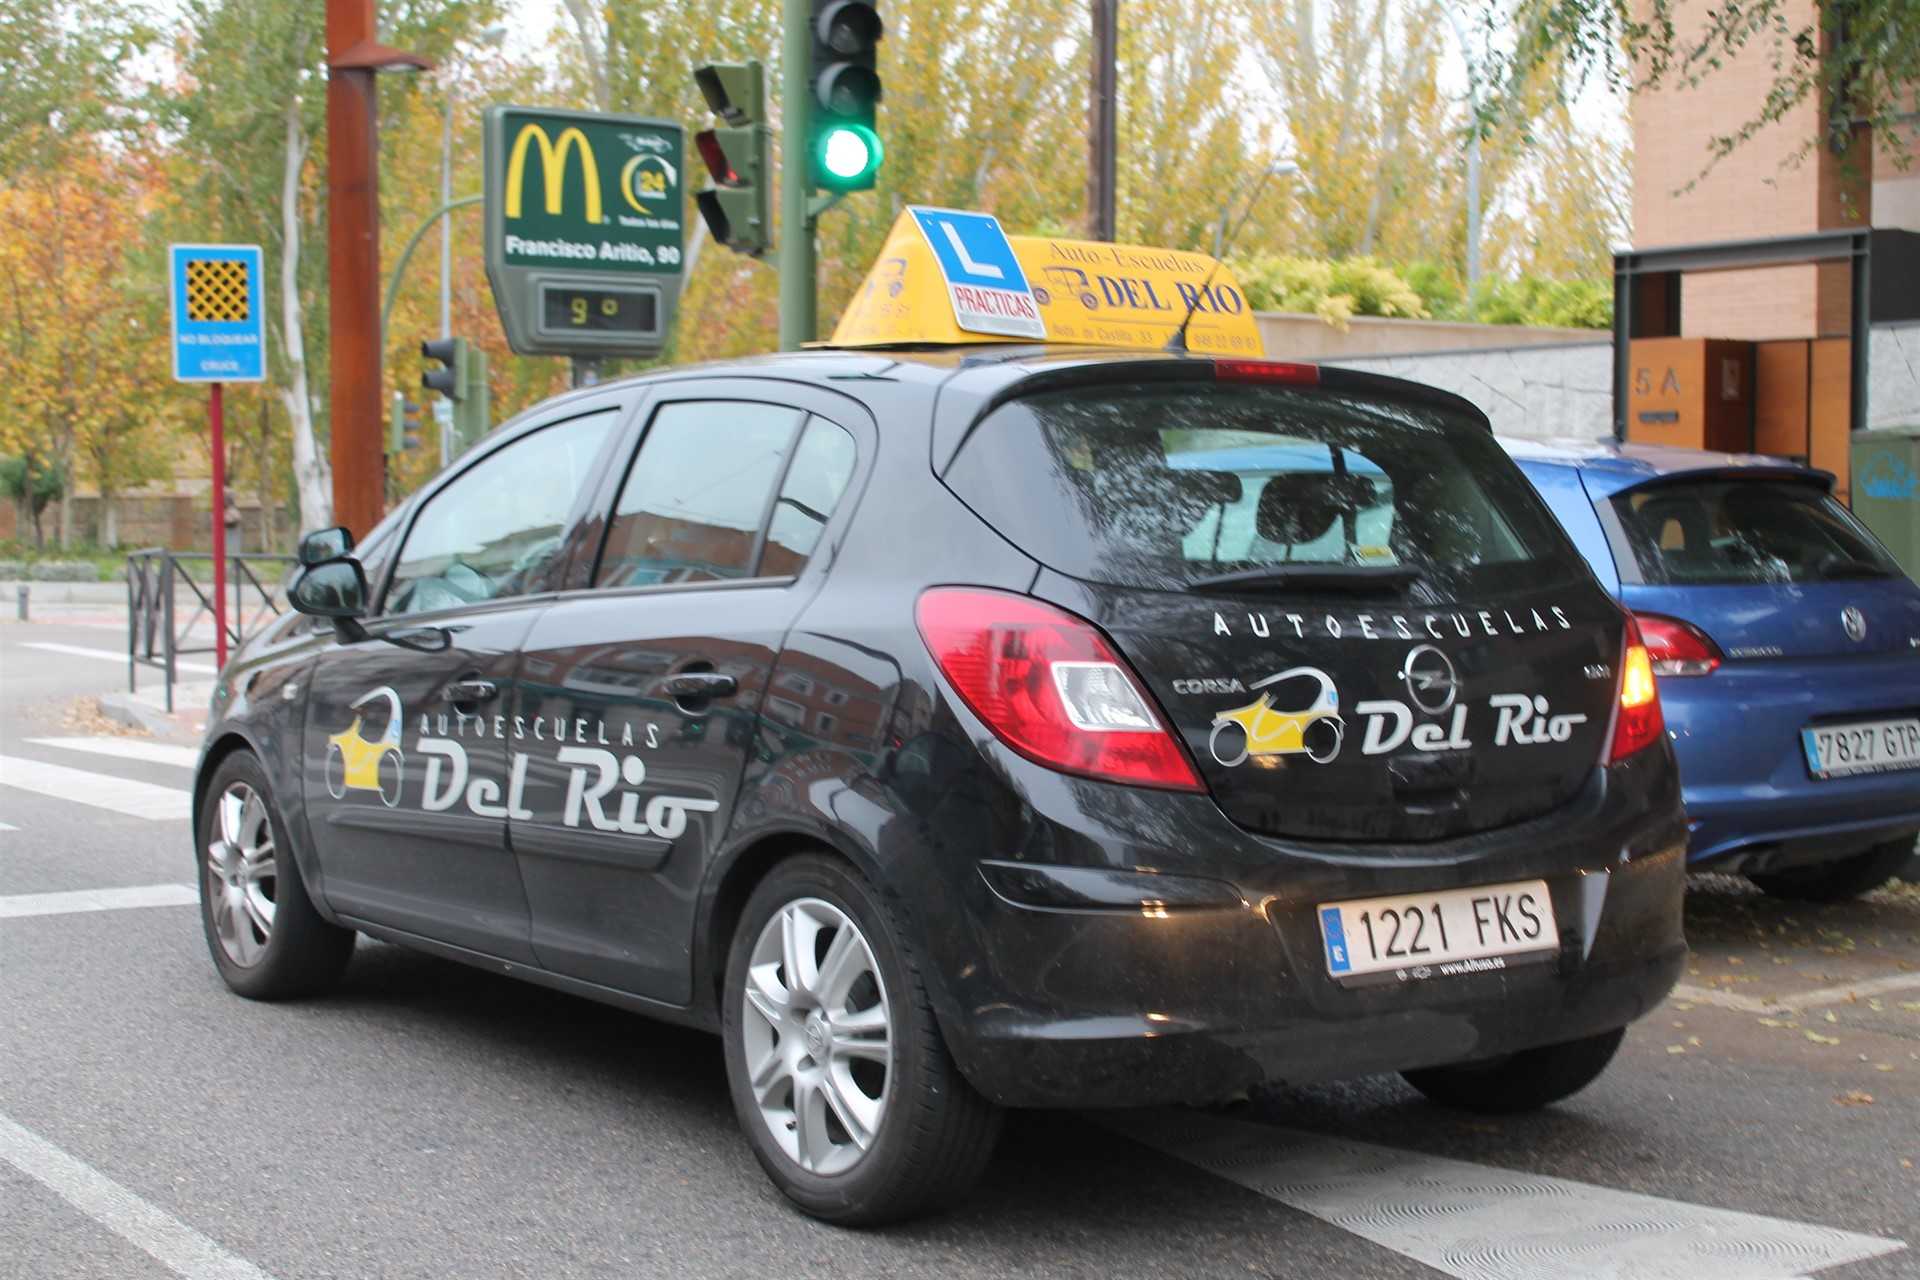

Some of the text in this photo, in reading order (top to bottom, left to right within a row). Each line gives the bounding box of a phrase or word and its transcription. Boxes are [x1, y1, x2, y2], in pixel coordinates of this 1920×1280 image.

[505, 234, 596, 259] Francisco
[657, 246, 681, 264] 90
[938, 220, 1006, 280] L
[953, 285, 1037, 320] PRACTICAS
[1097, 275, 1172, 312] DEL
[1660, 368, 1681, 395] A
[1212, 605, 1571, 640] AUTOESCUELAS
[1172, 678, 1247, 695] CORSA
[419, 712, 661, 749] AUTOESCUELAS
[1355, 693, 1588, 756] Del Rio
[1820, 728, 1875, 764] 7827
[416, 737, 720, 840] Del Rio
[1360, 893, 1541, 960] 1221 FKS
